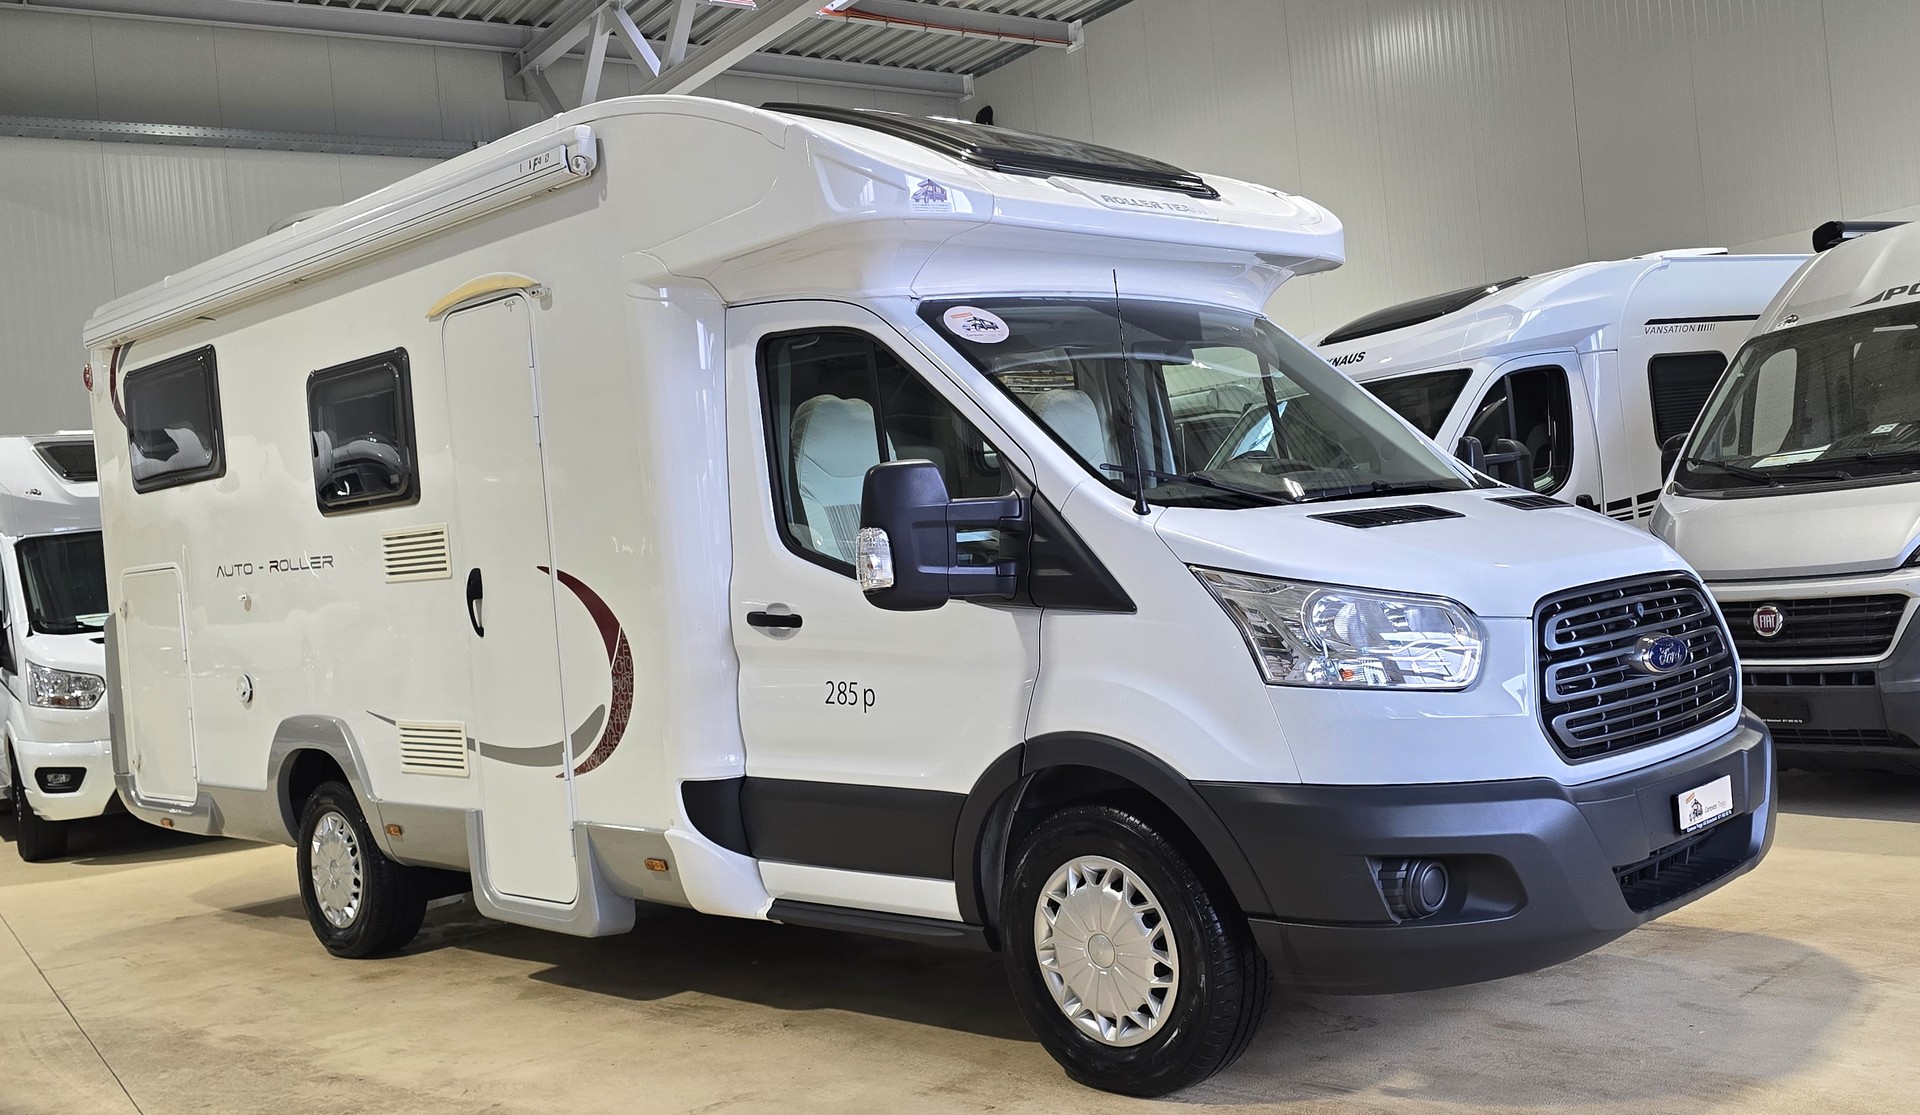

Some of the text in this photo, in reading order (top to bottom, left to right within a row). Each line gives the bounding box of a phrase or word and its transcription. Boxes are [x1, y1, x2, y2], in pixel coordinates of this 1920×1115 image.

[1100, 194, 1163, 210] ROLLER
[1644, 324, 1696, 335] VANSATION
[216, 562, 254, 578] AUTO
[268, 555, 334, 574] ROLLER
[1759, 614, 1776, 629] FIAT
[1659, 642, 1683, 666] Ford
[825, 680, 876, 714] 285 p
